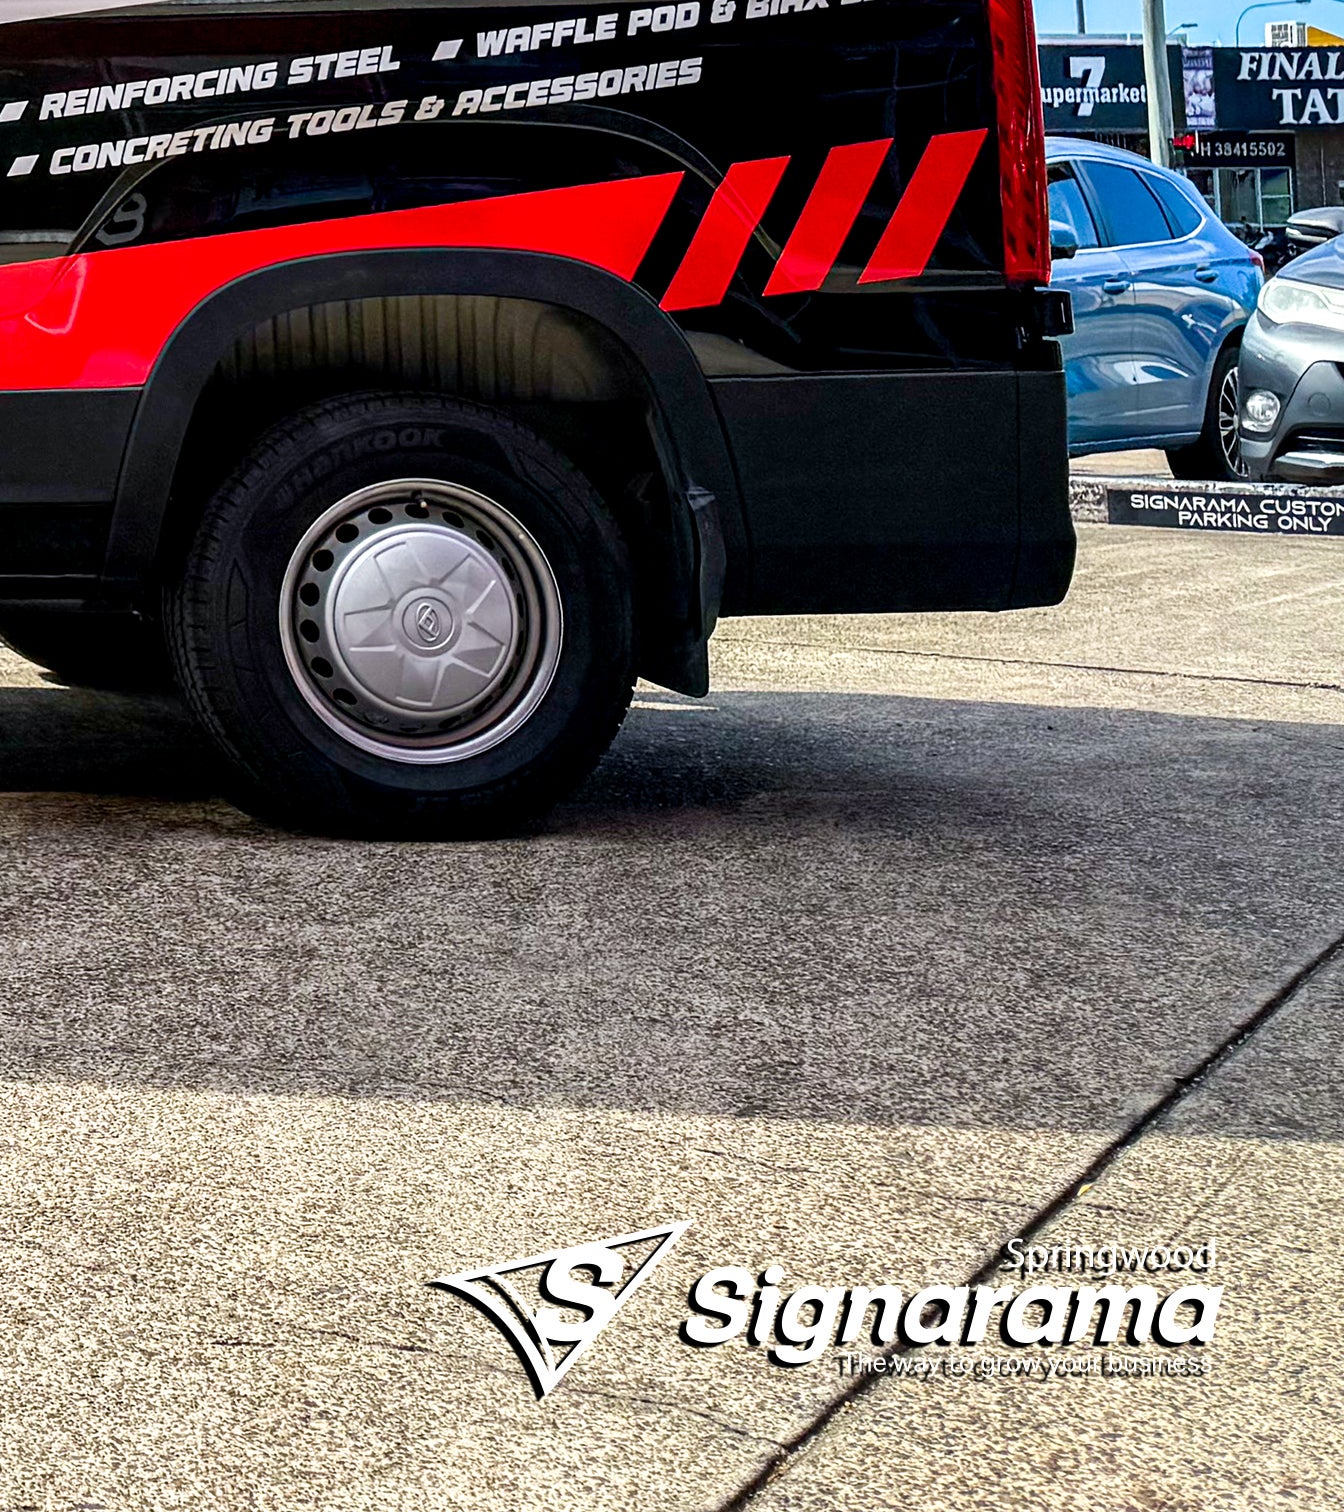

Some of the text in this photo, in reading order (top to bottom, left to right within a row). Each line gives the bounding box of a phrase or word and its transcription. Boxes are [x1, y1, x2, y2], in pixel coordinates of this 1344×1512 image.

[476, 13, 619, 58] WAFFLE
[627, 2, 701, 36] POD
[39, 45, 400, 121] REINFORCING STEEL
[1070, 56, 1105, 117] 7
[1236, 51, 1344, 81] FINAL
[49, 57, 703, 175] CONCRETING TOOLS & ACCESSORIES
[1040, 82, 1148, 108] upermarket
[1130, 494, 1250, 513] SIGNARAMA
[1178, 511, 1333, 532] PARKING ONLY
